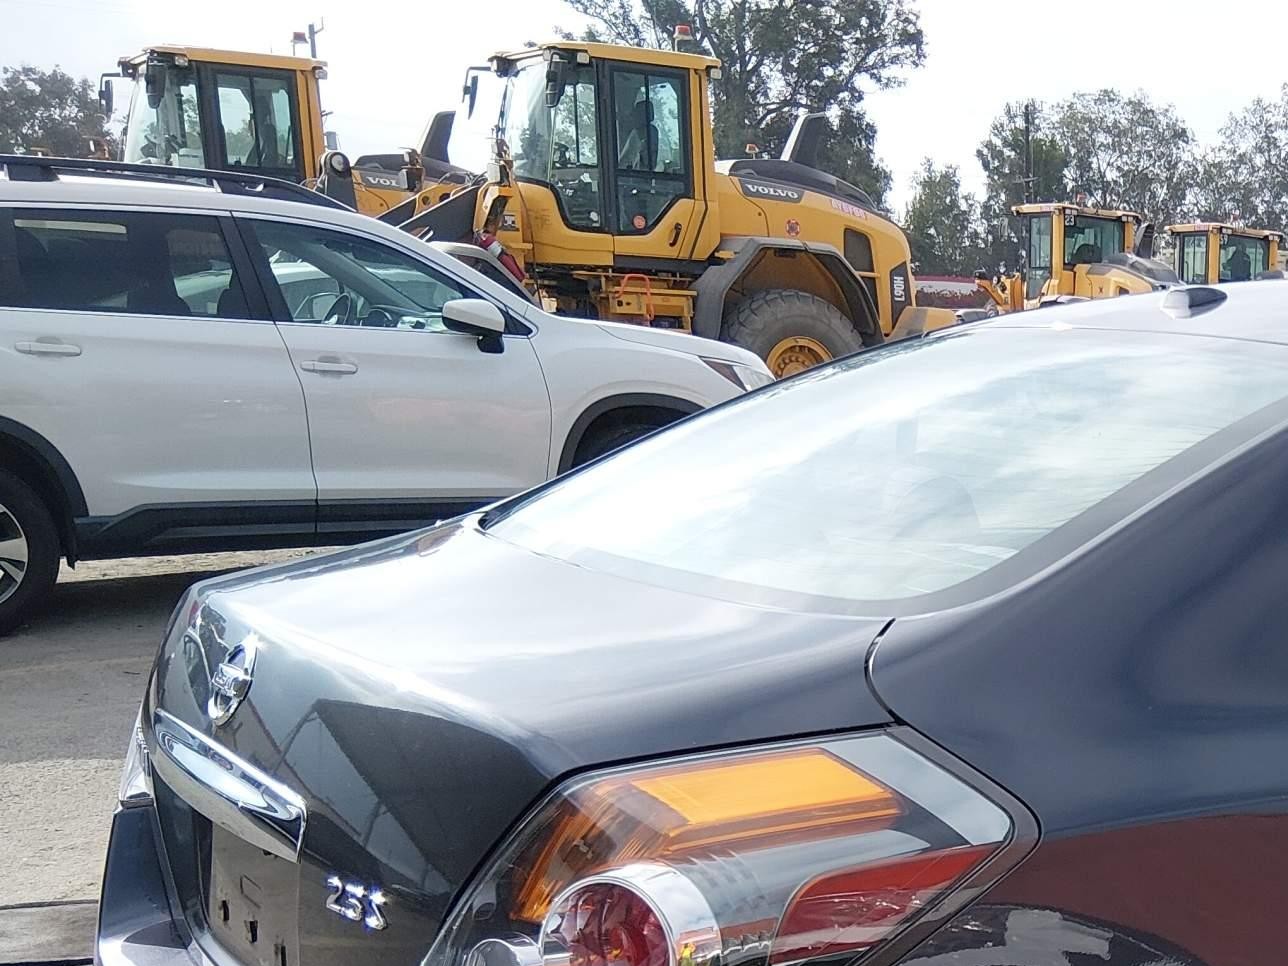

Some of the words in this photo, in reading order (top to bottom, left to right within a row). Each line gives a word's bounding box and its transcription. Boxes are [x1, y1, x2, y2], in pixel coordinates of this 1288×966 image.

[366, 176, 400, 187] VOL
[747, 183, 799, 199] VOLVO
[1065, 214, 1075, 226] 23
